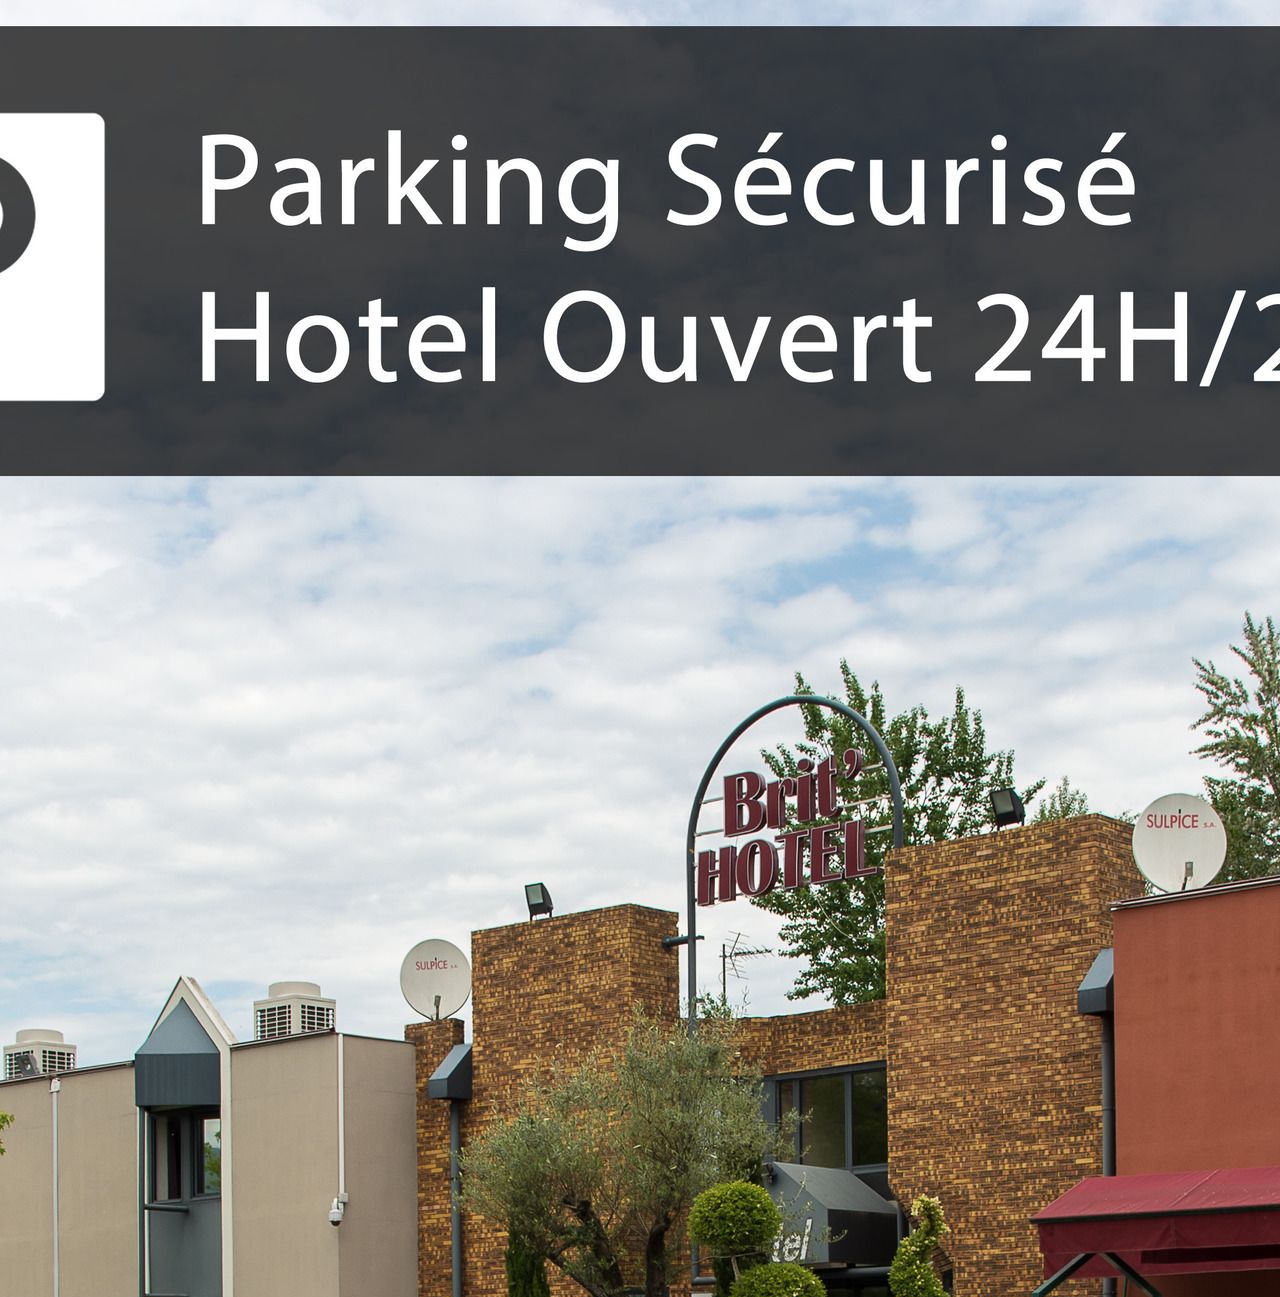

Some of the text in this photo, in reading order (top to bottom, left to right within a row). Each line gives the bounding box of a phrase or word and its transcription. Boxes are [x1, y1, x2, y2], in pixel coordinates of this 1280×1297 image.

[1146, 814, 1198, 829] SULPICE
[697, 820, 884, 907] HOTEL
[415, 960, 448, 970] SULPICE
